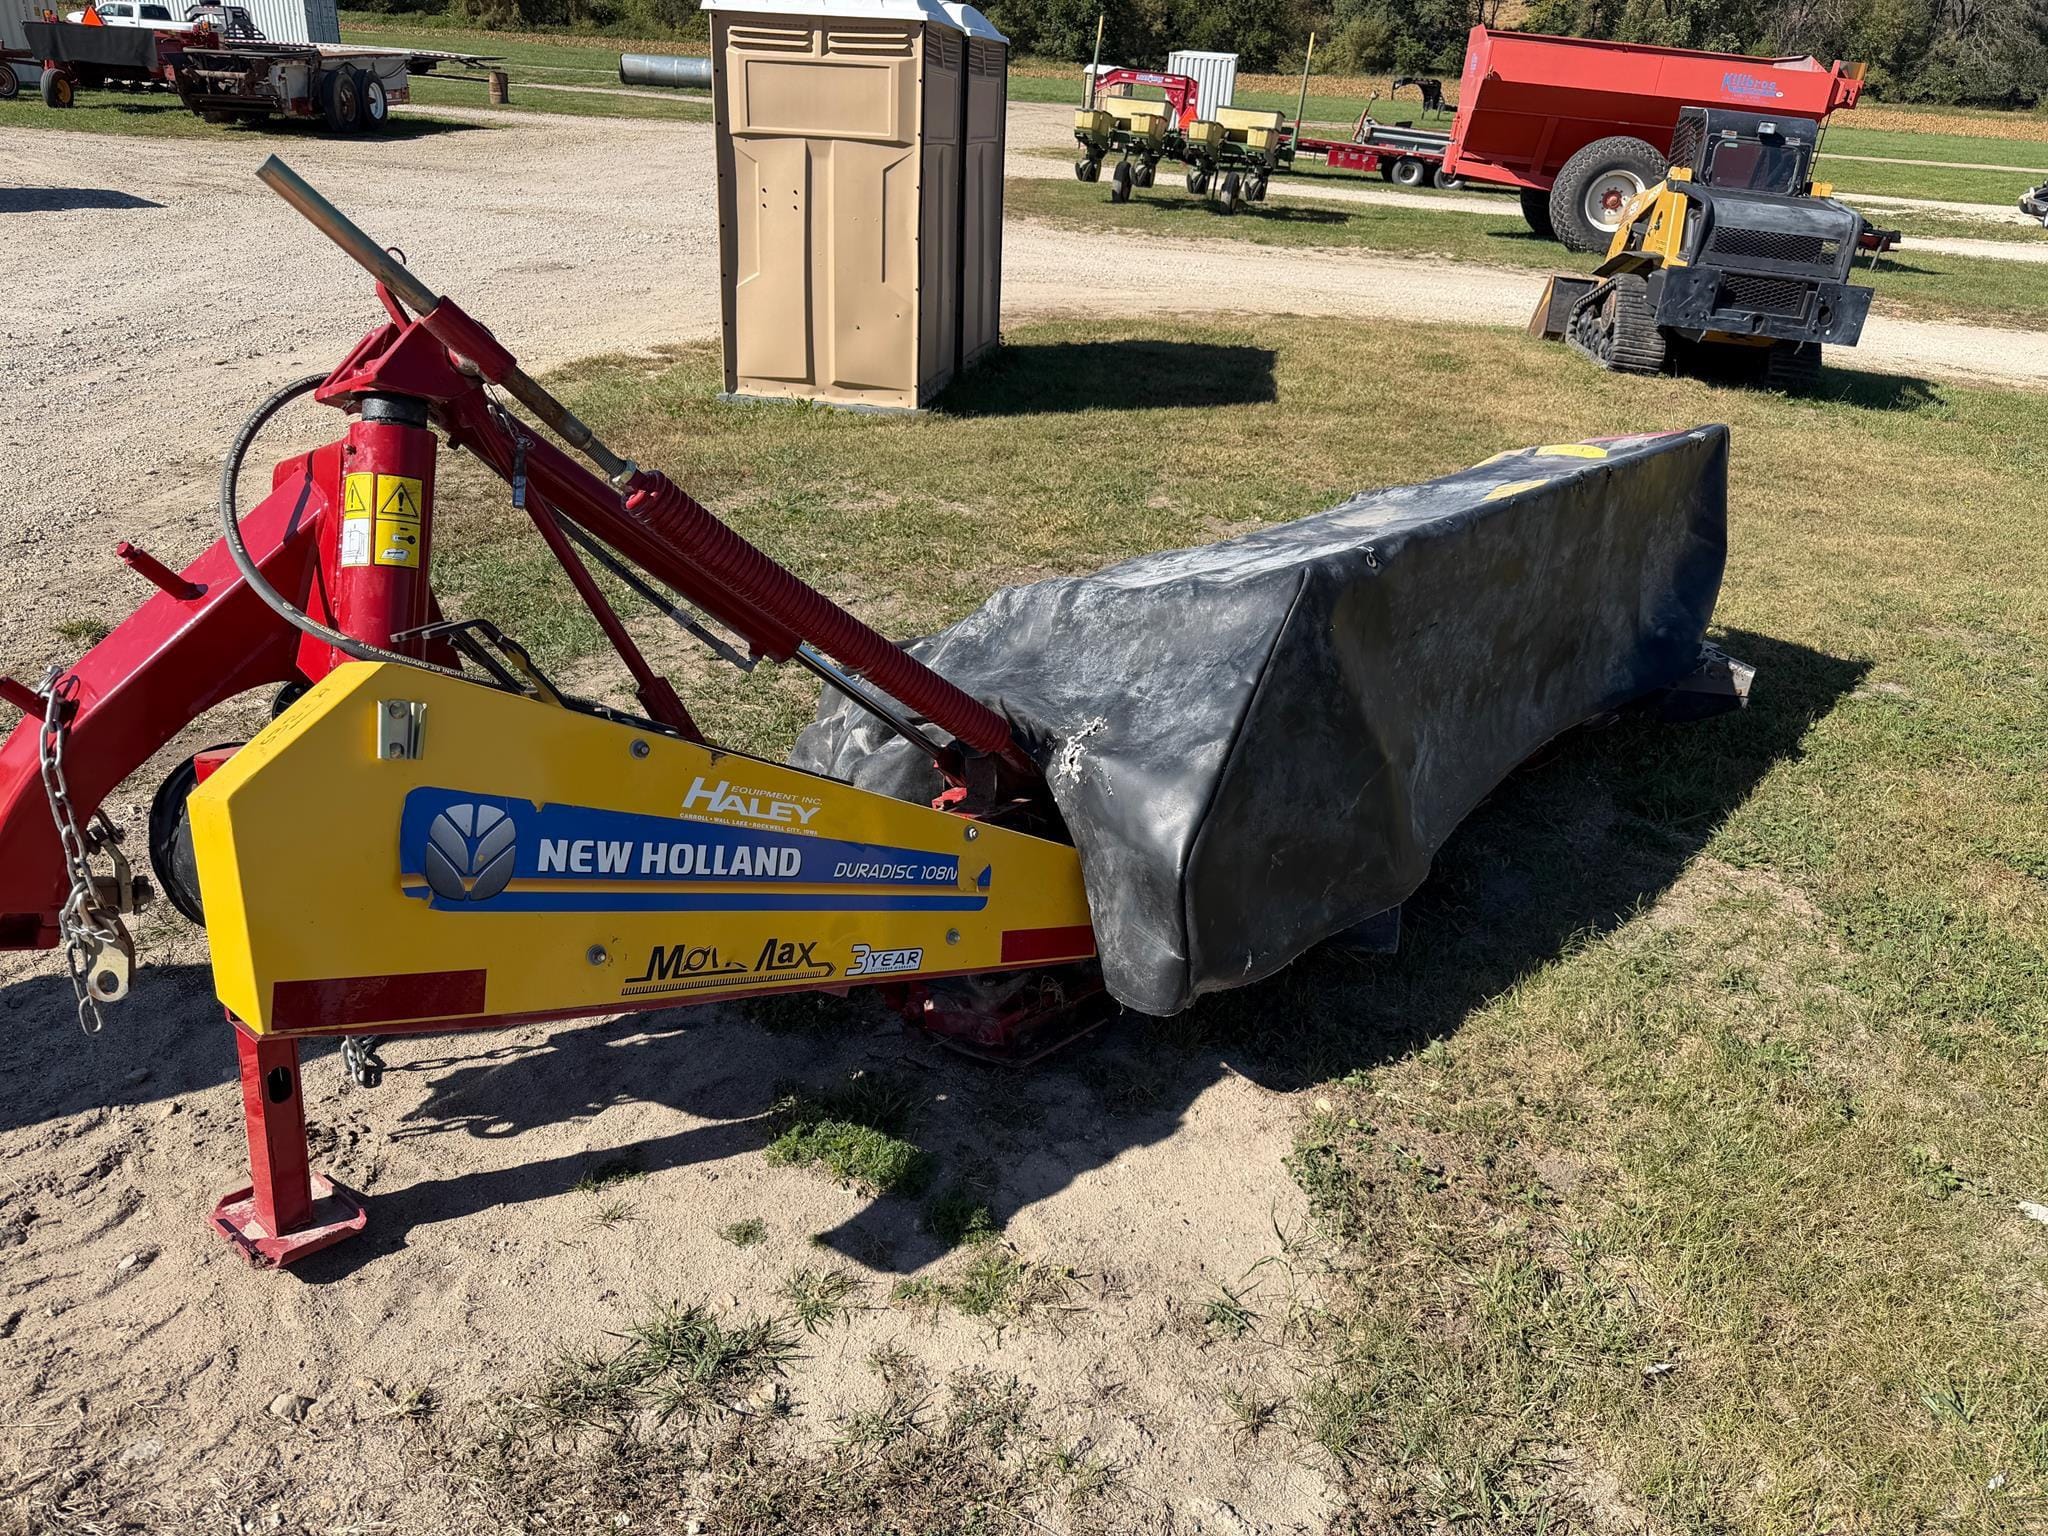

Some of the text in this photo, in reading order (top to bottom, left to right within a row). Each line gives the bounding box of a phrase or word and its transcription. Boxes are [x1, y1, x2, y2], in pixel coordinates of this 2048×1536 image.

[379, 649, 429, 668] WEARGUARD
[442, 667, 460, 676] INCH
[681, 776, 821, 825] HALEY
[731, 785, 823, 806] EQUIPMENT INC.
[679, 812, 709, 822] CARROLL
[732, 819, 748, 827] LAKE
[537, 838, 802, 877] NEW HOLLAND
[833, 862, 958, 881] DURADISC 108N
[845, 944, 919, 976] 3 YEAR
